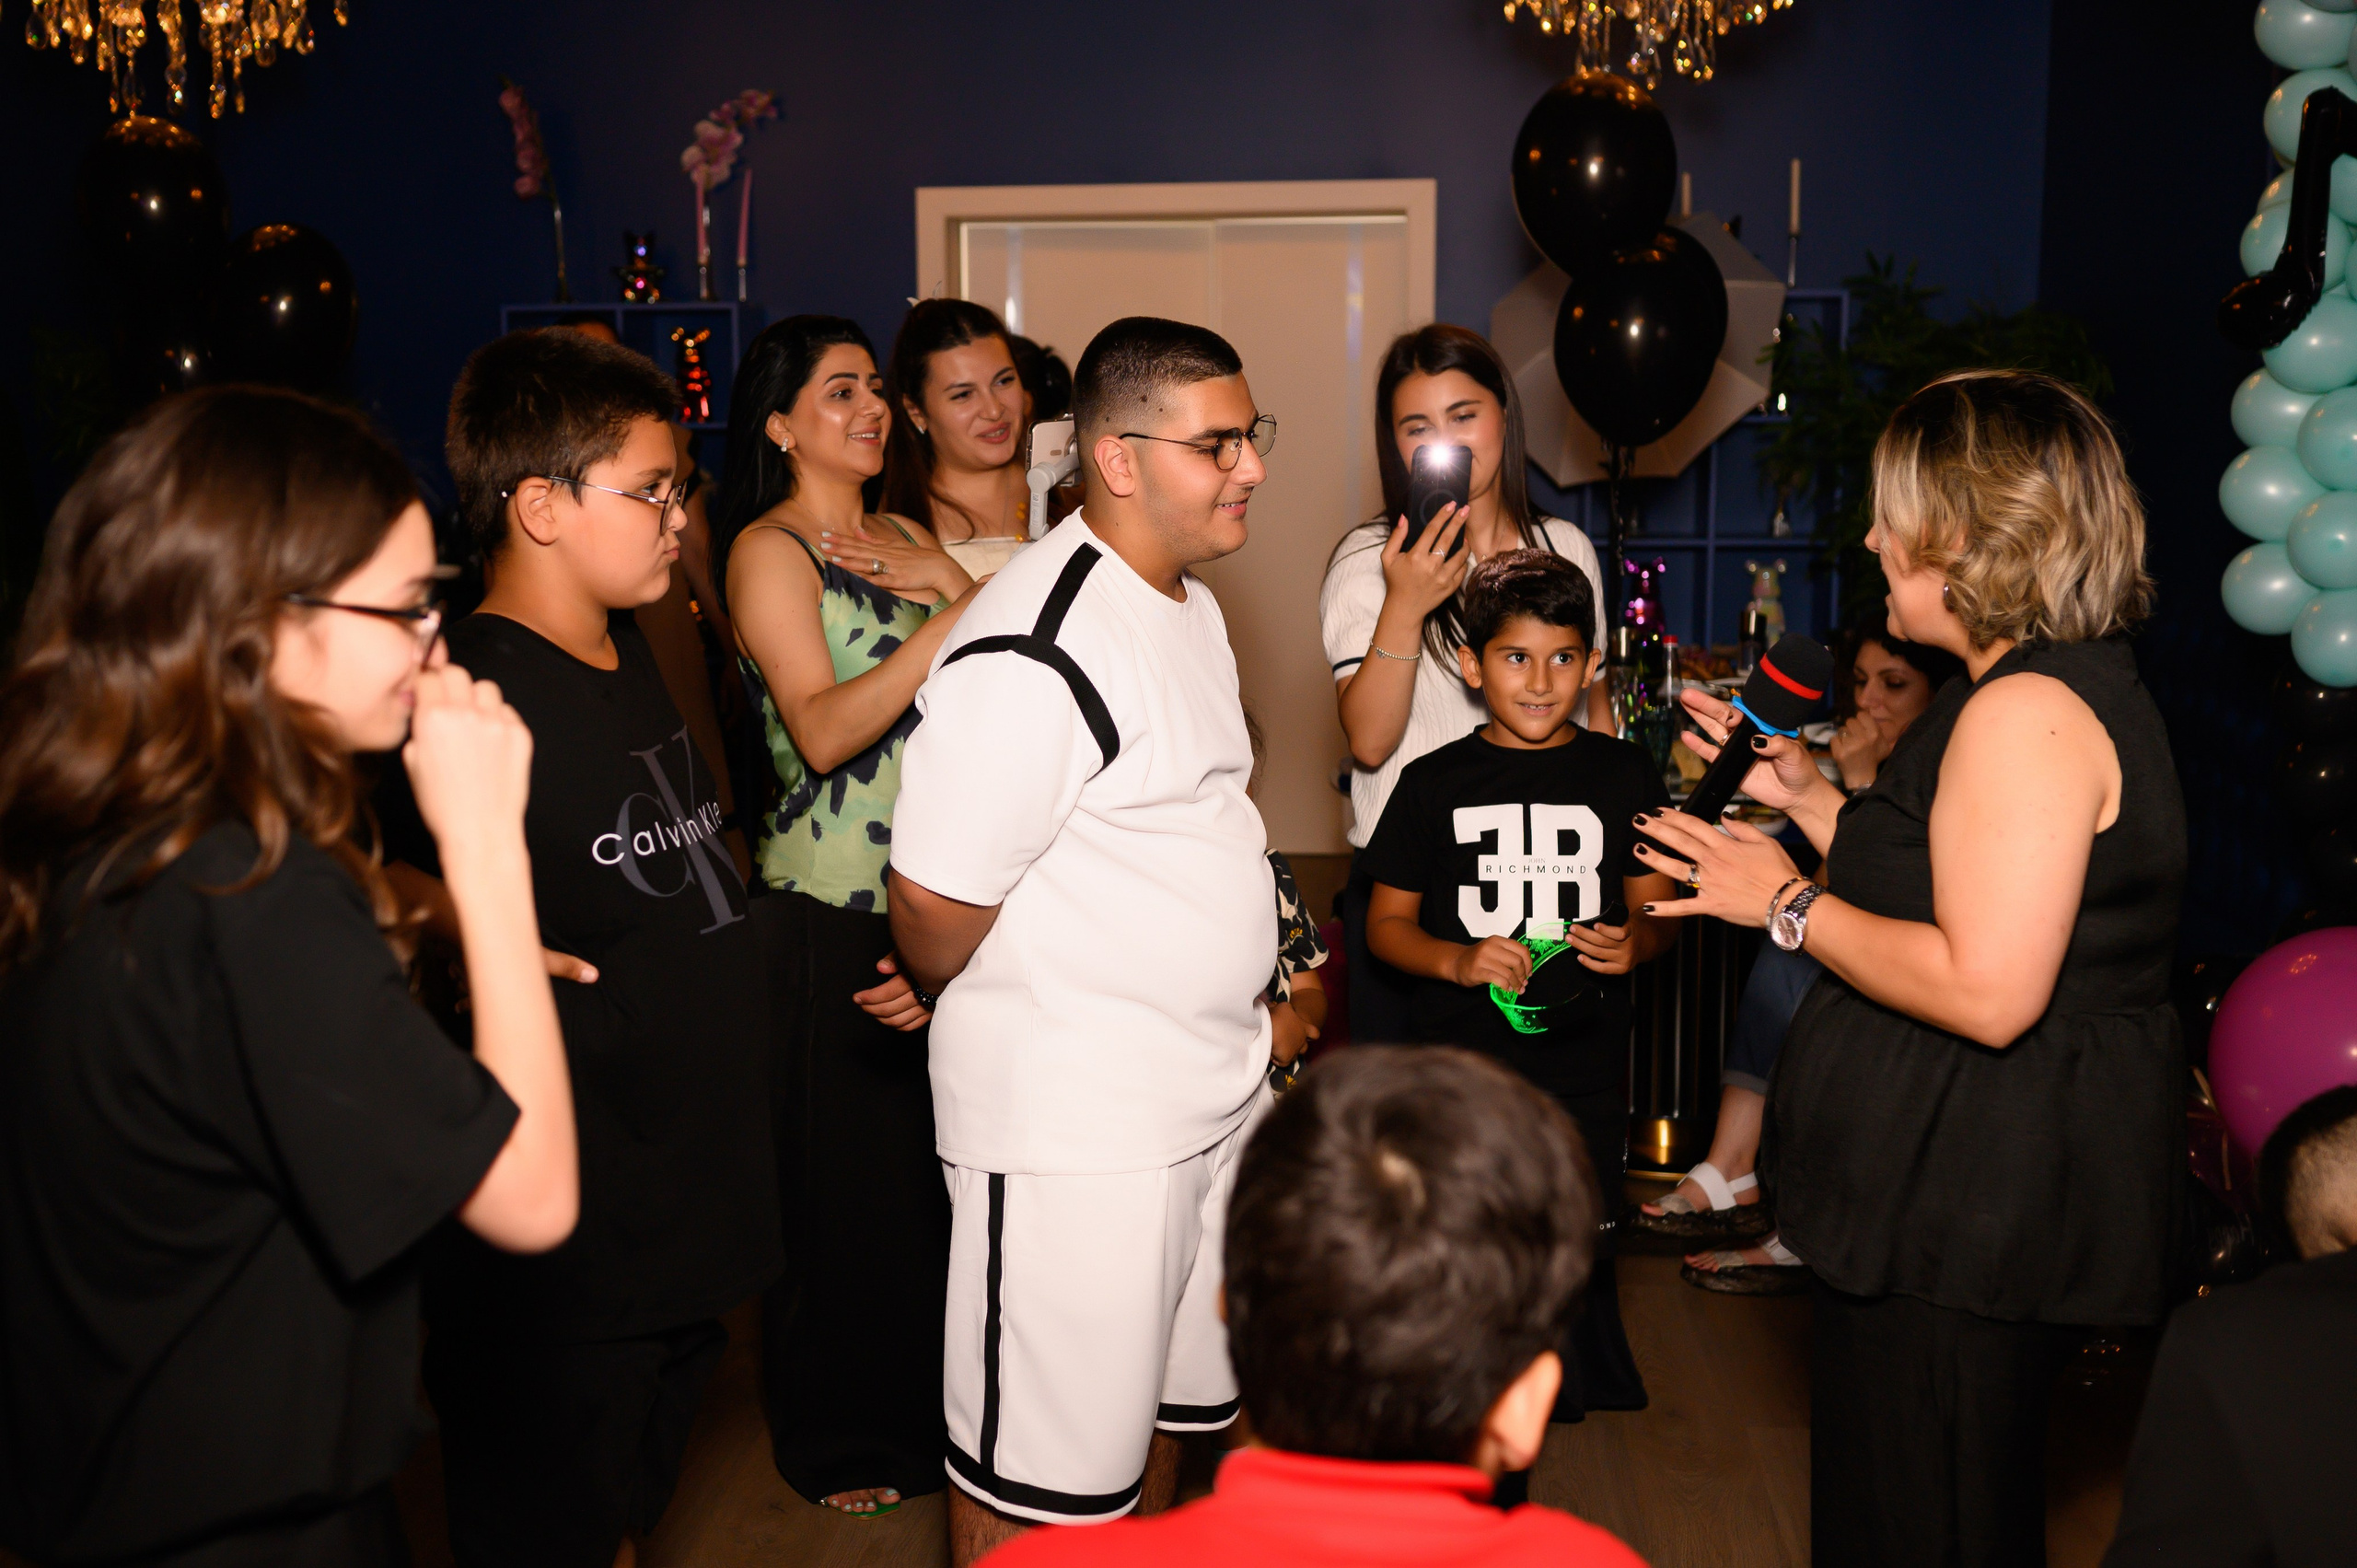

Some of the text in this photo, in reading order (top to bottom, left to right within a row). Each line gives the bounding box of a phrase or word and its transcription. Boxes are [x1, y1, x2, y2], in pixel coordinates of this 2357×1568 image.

[591, 801, 723, 865] Calvin Kle
[1485, 865, 1586, 875] RICHMOND
[1599, 1221, 1616, 1230] OND
